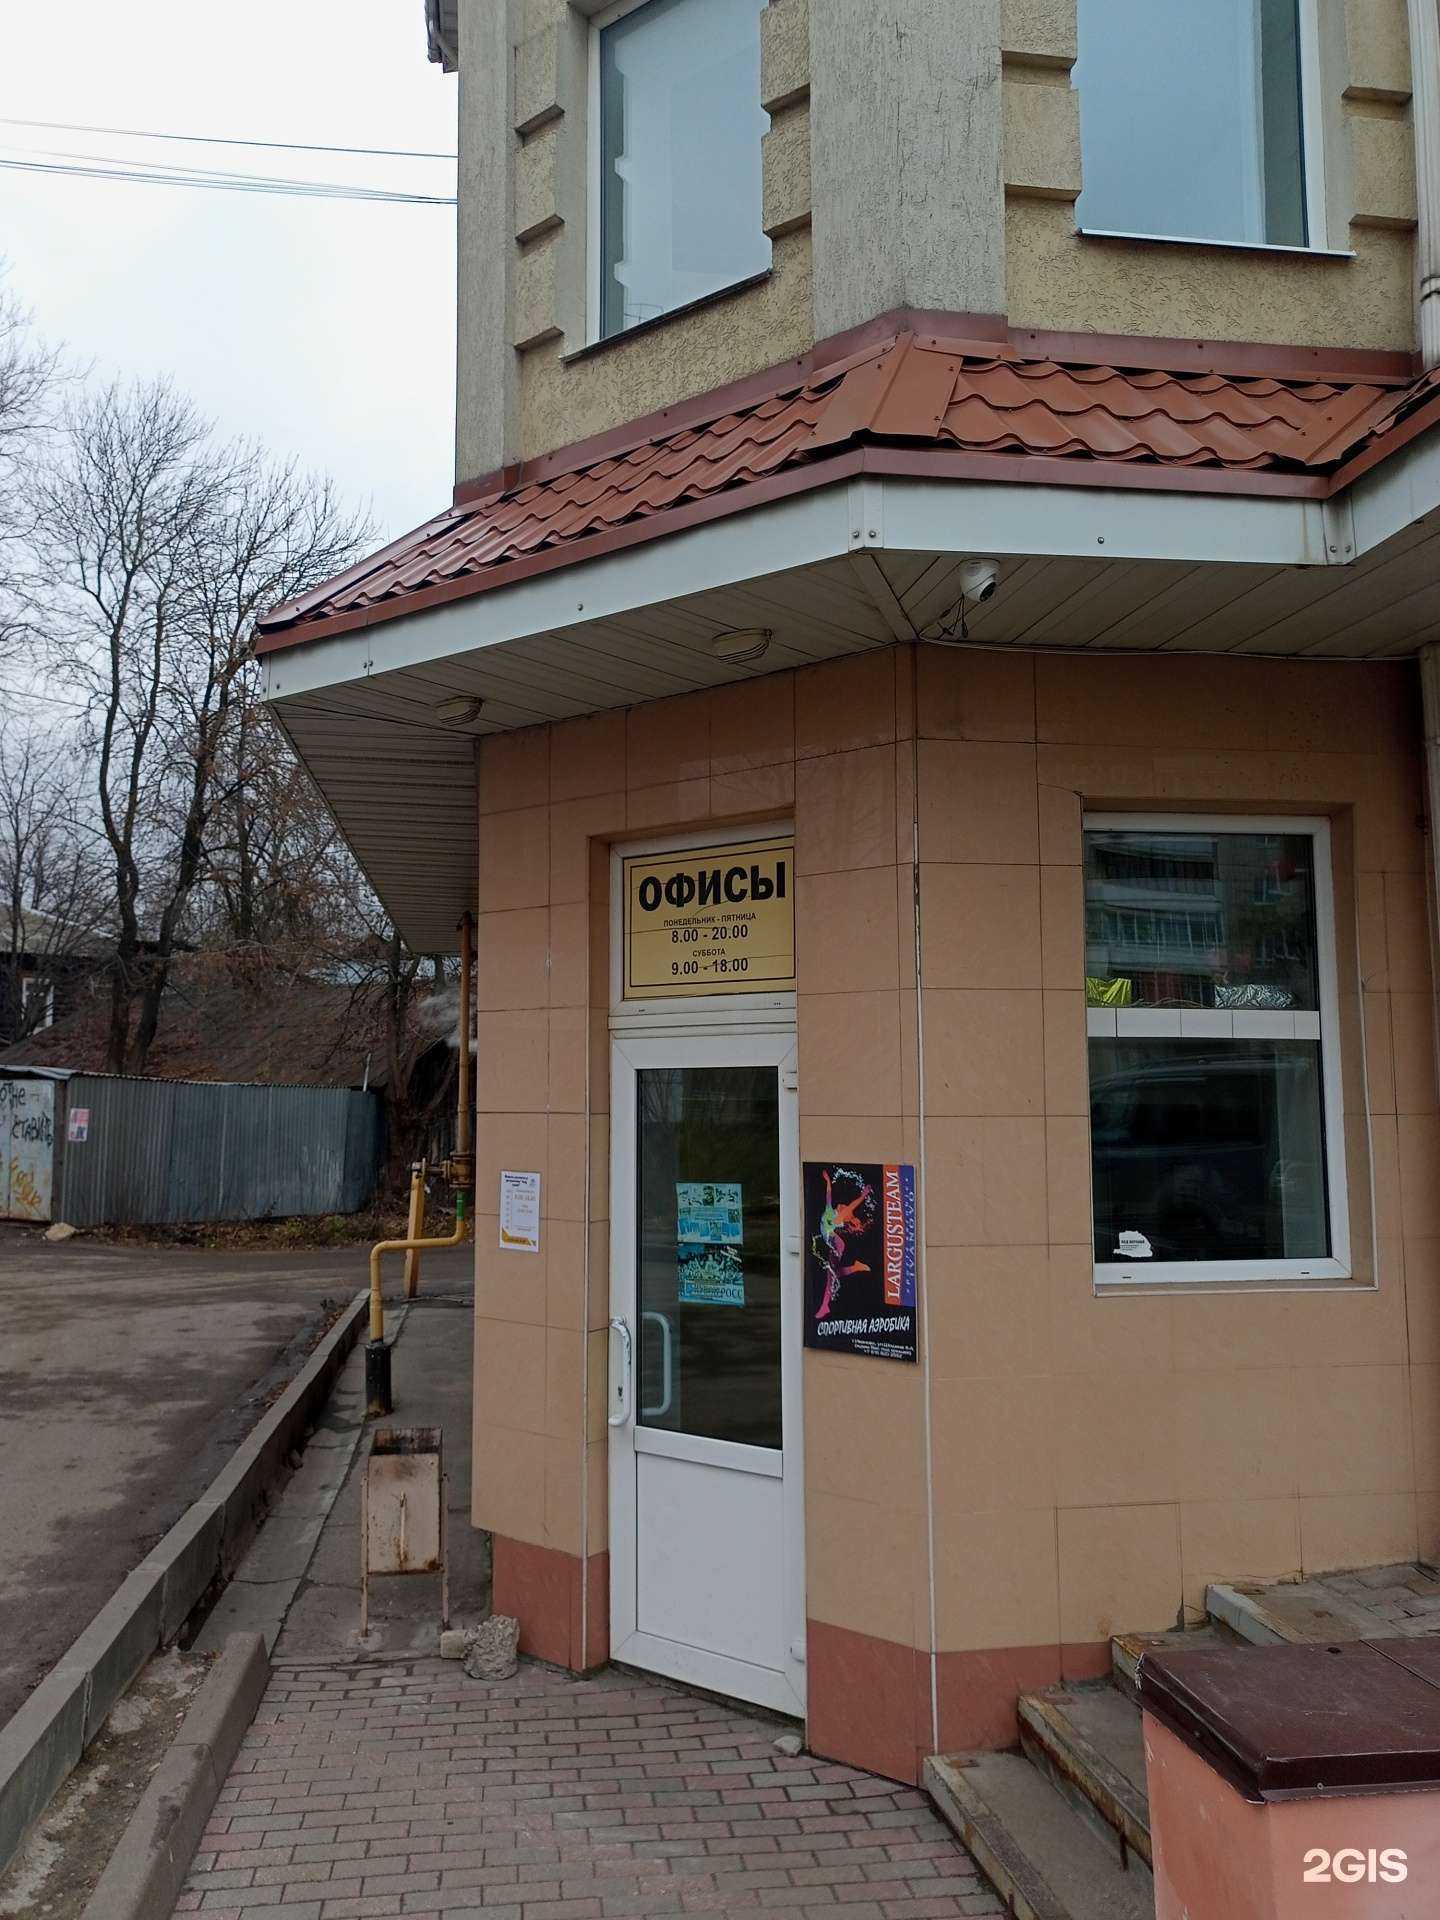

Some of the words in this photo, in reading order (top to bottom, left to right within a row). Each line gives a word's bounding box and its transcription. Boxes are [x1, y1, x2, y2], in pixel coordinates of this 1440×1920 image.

[639, 861, 786, 912] ОФИСЫ
[663, 915, 716, 928] ПОНЕДЕЛЬНИК
[721, 912, 757, 923] ПЯТНИЦА
[671, 929, 699, 943] 8.00
[711, 924, 748, 940] 20.00
[692, 948, 726, 958] СУББОТА
[671, 961, 699, 975] 9.00
[713, 957, 748, 973] 18.00
[886, 1170, 904, 1299] LARGUSTEAM
[817, 1318, 868, 1336] СПОРТИВНАЯ
[868, 1315, 910, 1334] АЭРОБИКА
